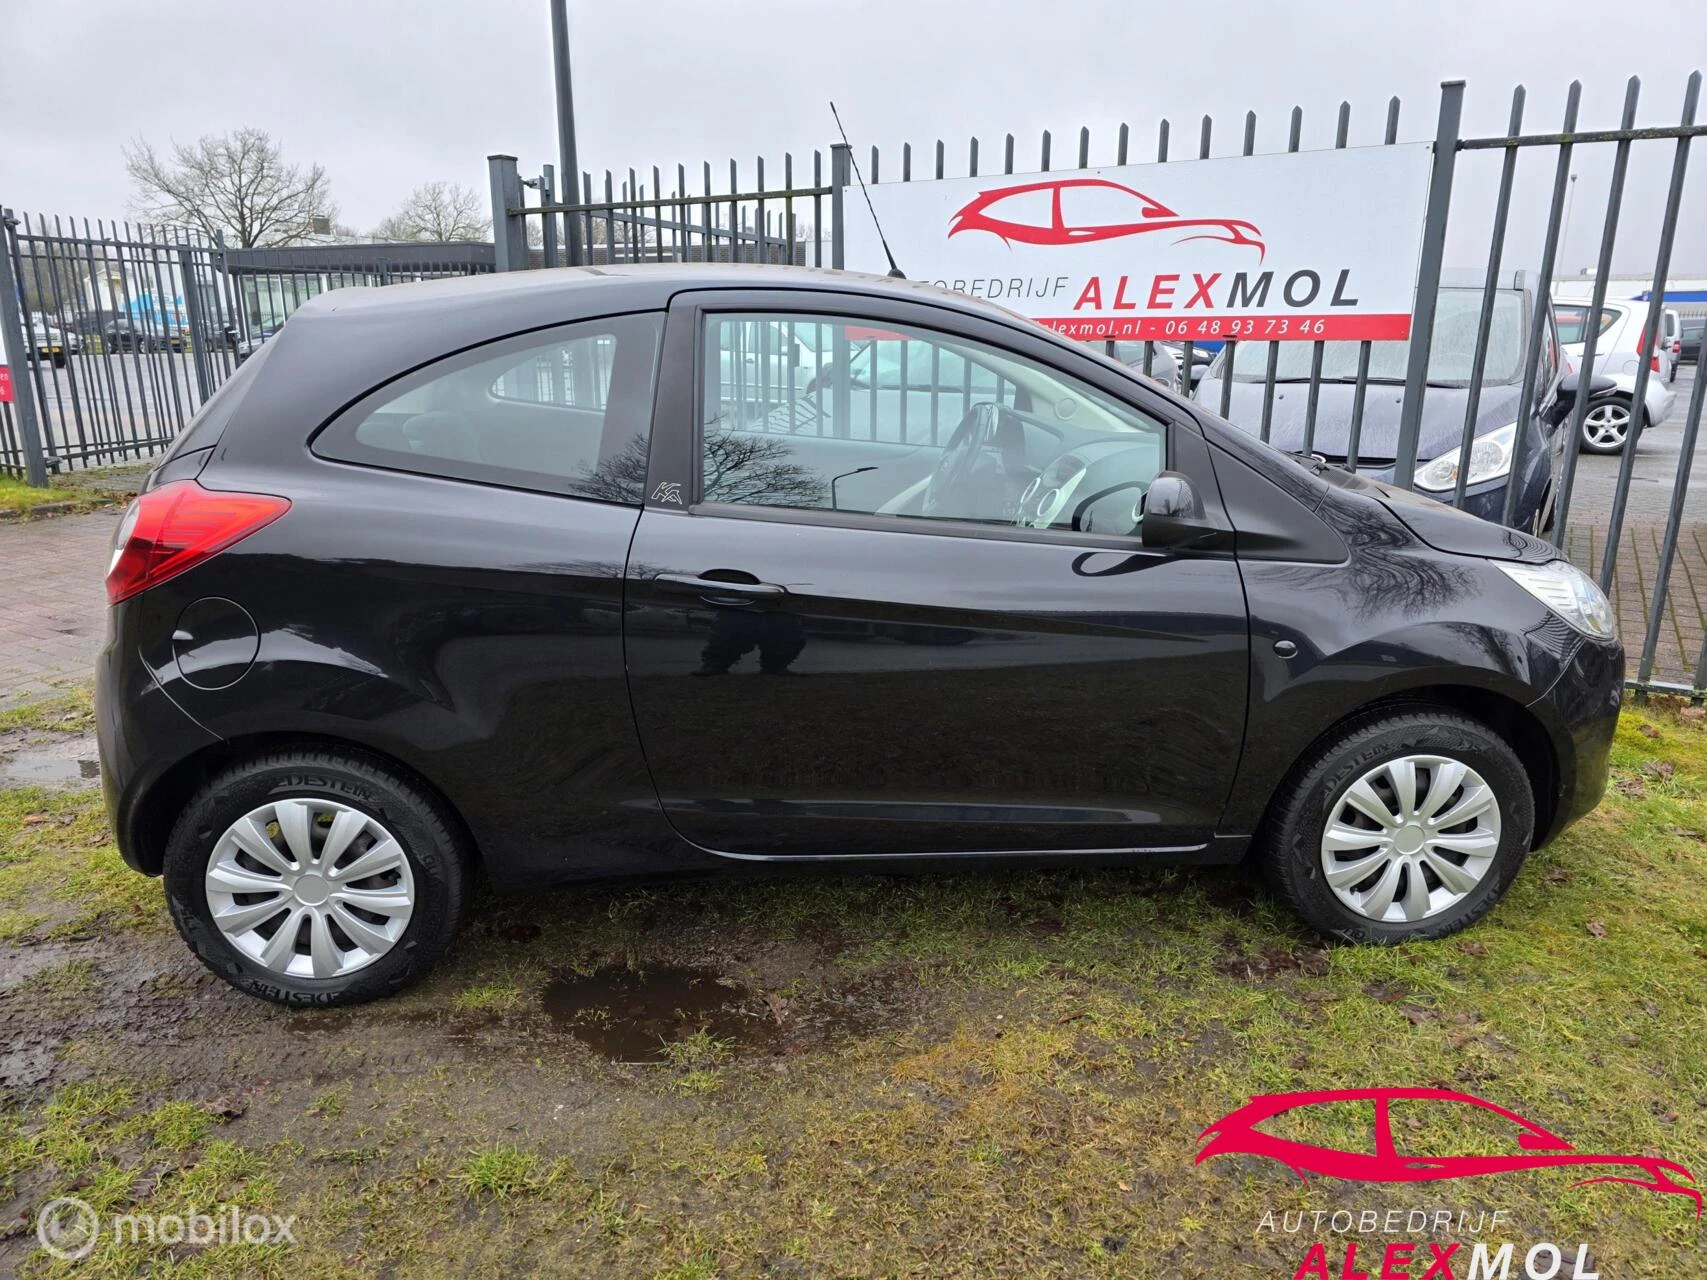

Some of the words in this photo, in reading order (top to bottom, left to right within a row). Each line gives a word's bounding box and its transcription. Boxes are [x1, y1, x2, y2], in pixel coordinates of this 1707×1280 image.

[1073, 269, 1359, 310] ALEXMOL
[1165, 320, 1188, 334] 06
[1198, 320, 1221, 333] 48
[1231, 320, 1254, 334] 93
[1265, 320, 1289, 334] 73
[1299, 319, 1325, 333] 46
